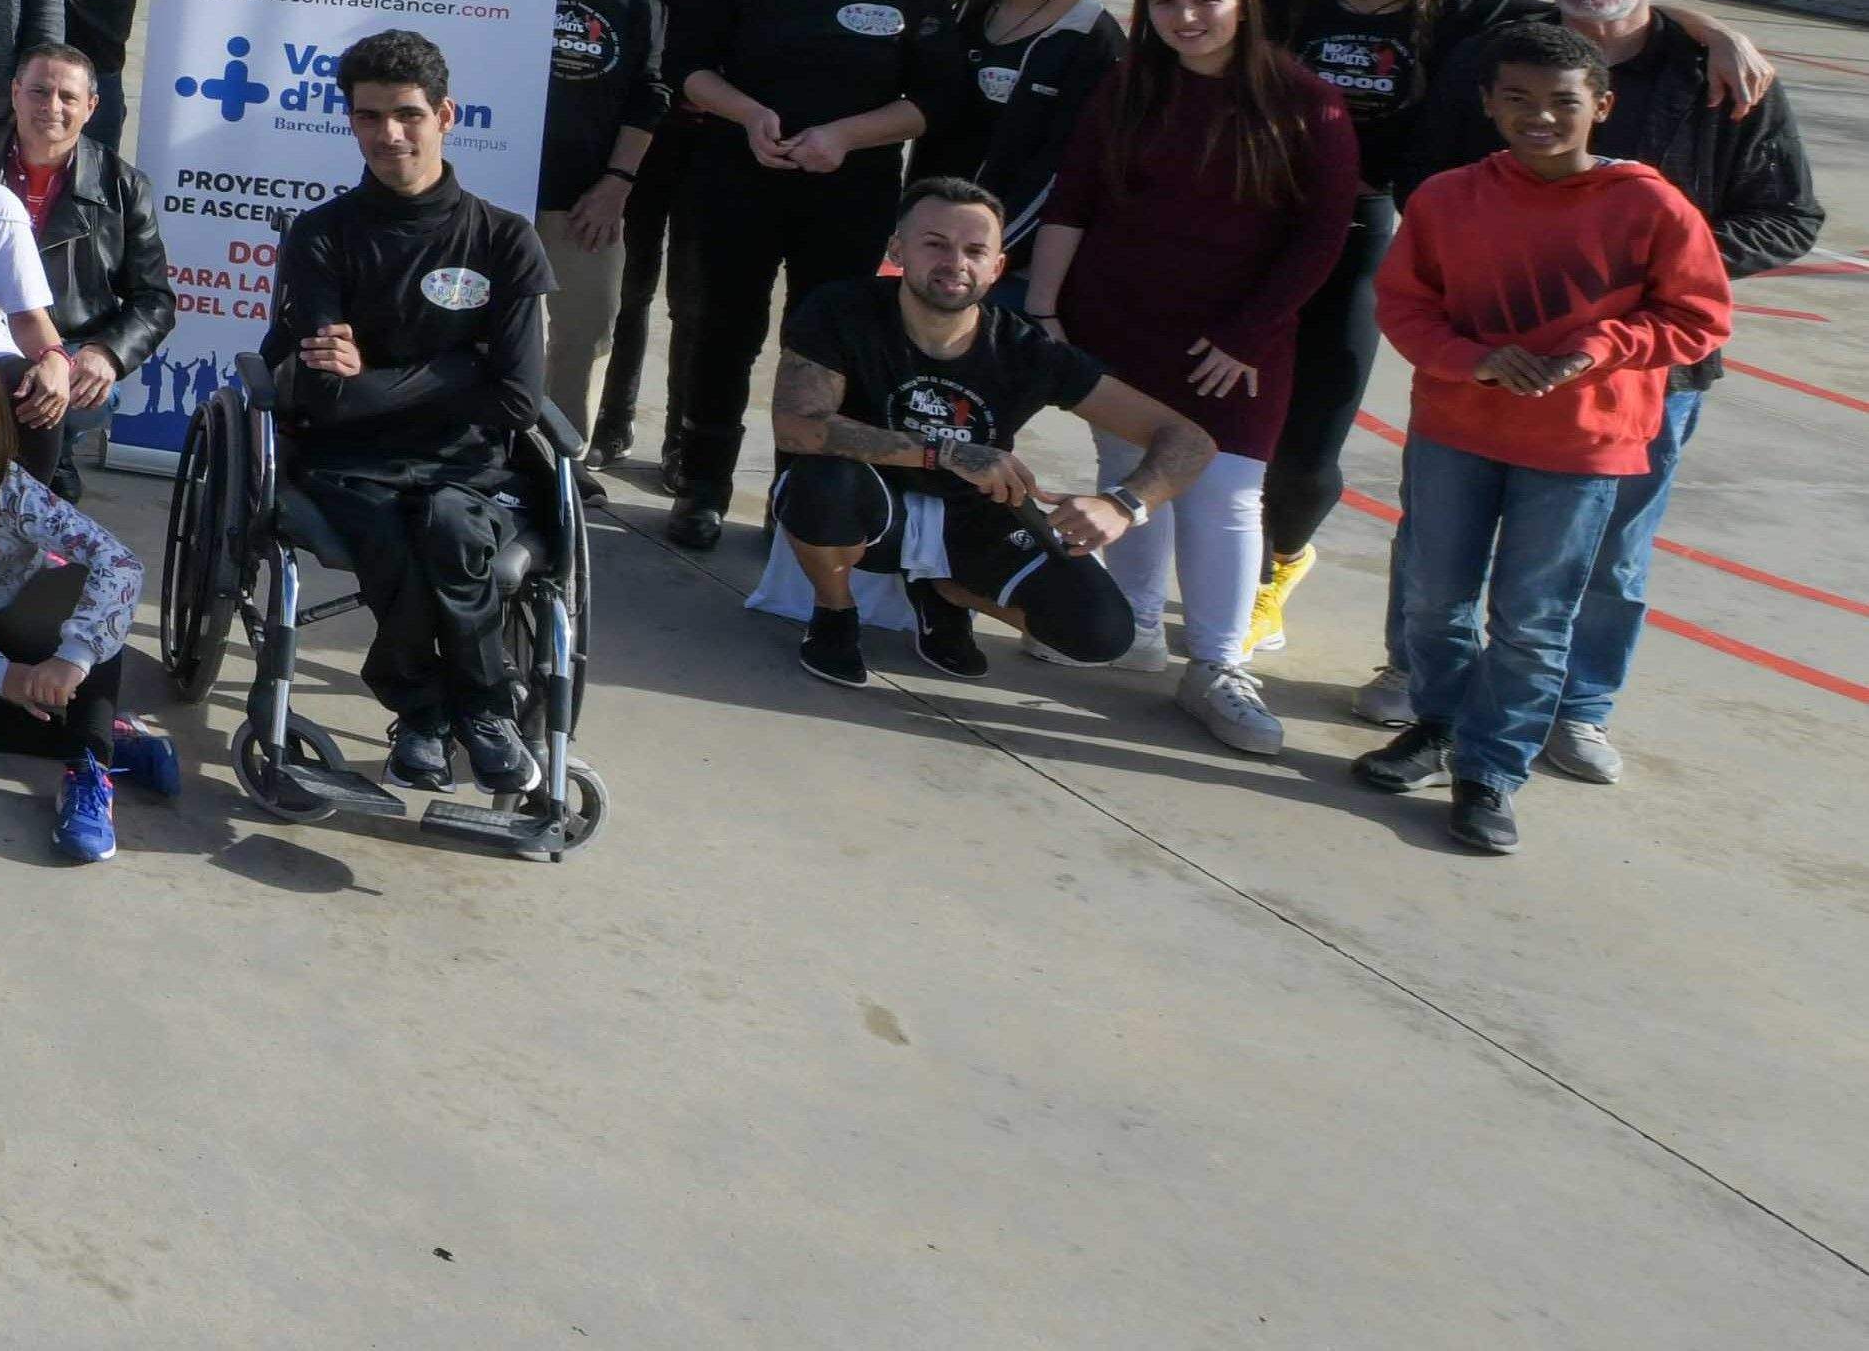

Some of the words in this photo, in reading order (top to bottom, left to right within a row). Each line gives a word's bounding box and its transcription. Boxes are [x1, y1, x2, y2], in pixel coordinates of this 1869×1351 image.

[284, 43, 340, 78] Va
[274, 116, 353, 137] Barcelon
[177, 169, 326, 201] PROYECTO
[164, 195, 195, 214] DE
[167, 264, 232, 290] PARA
[177, 293, 226, 317] DEL
